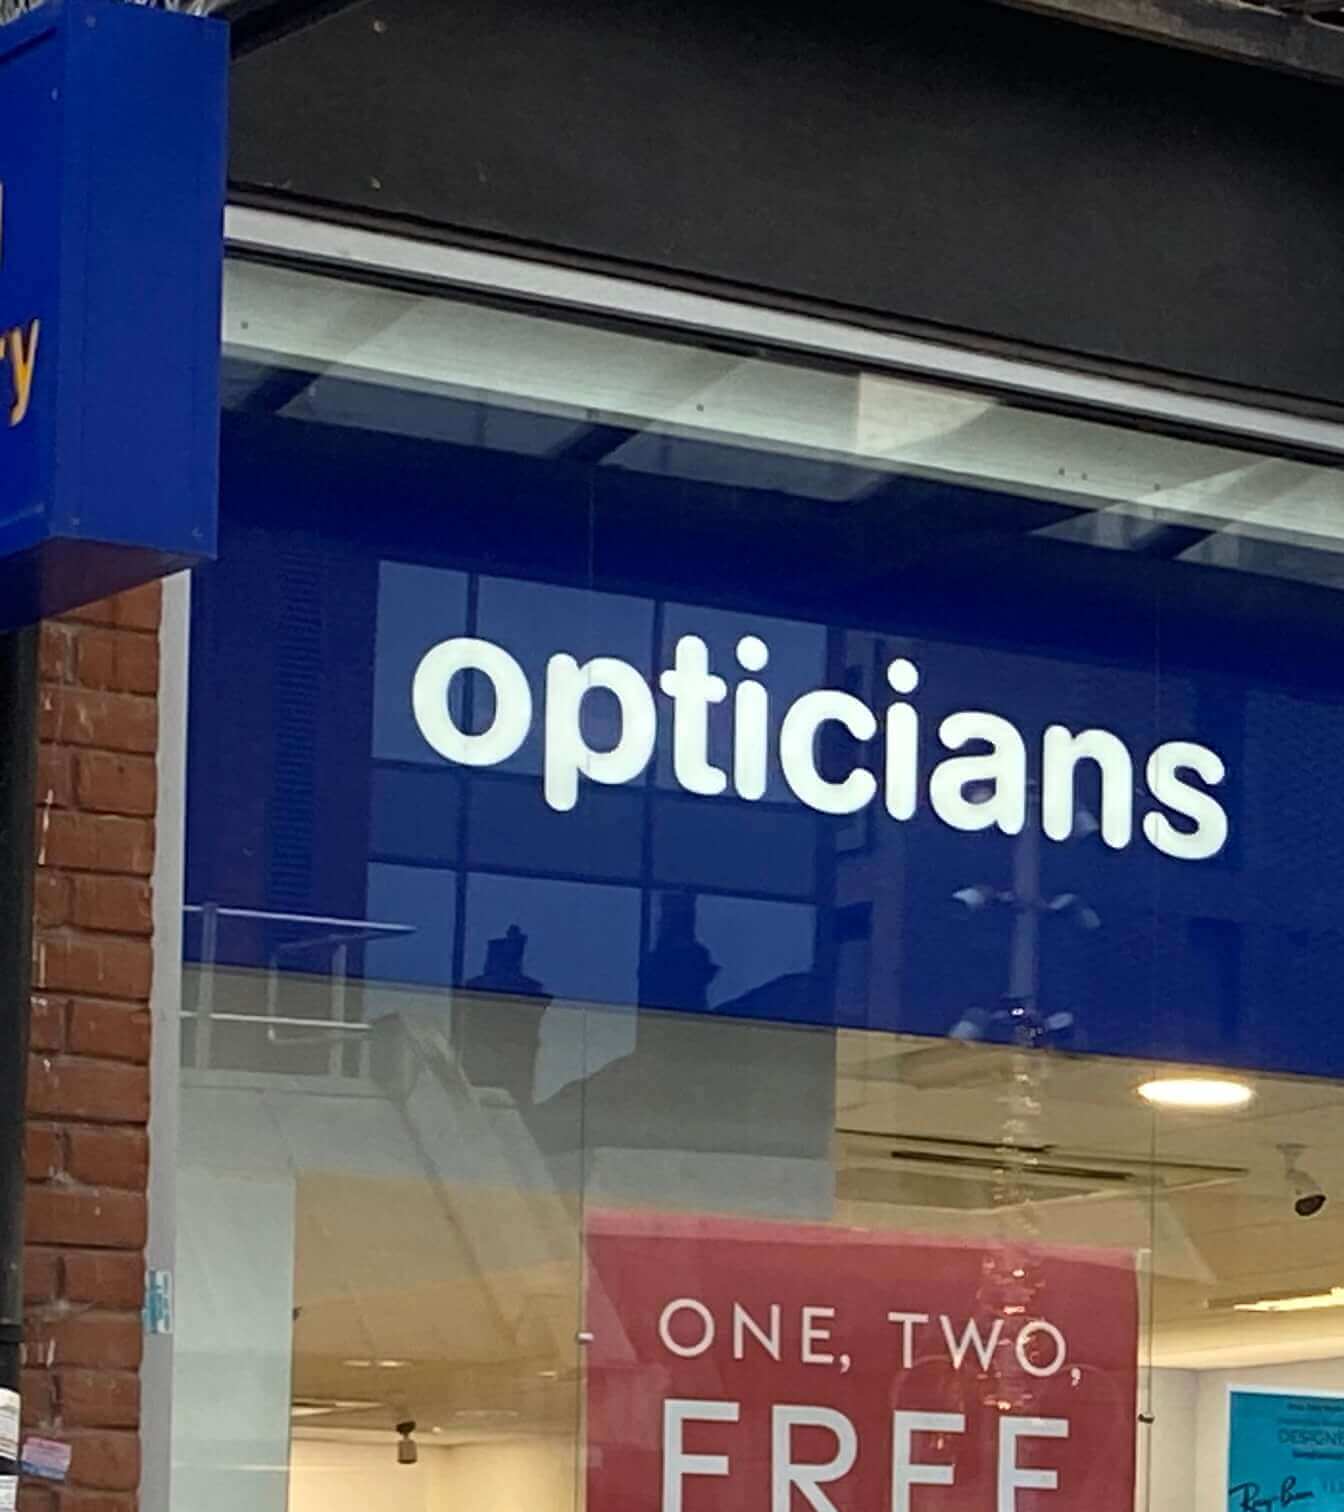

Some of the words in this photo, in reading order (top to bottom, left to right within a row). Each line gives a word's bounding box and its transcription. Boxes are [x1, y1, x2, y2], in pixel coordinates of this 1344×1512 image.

[411, 634, 1229, 860] opticians
[658, 1298, 853, 1373] ONE,
[887, 1312, 1082, 1387] TWO,
